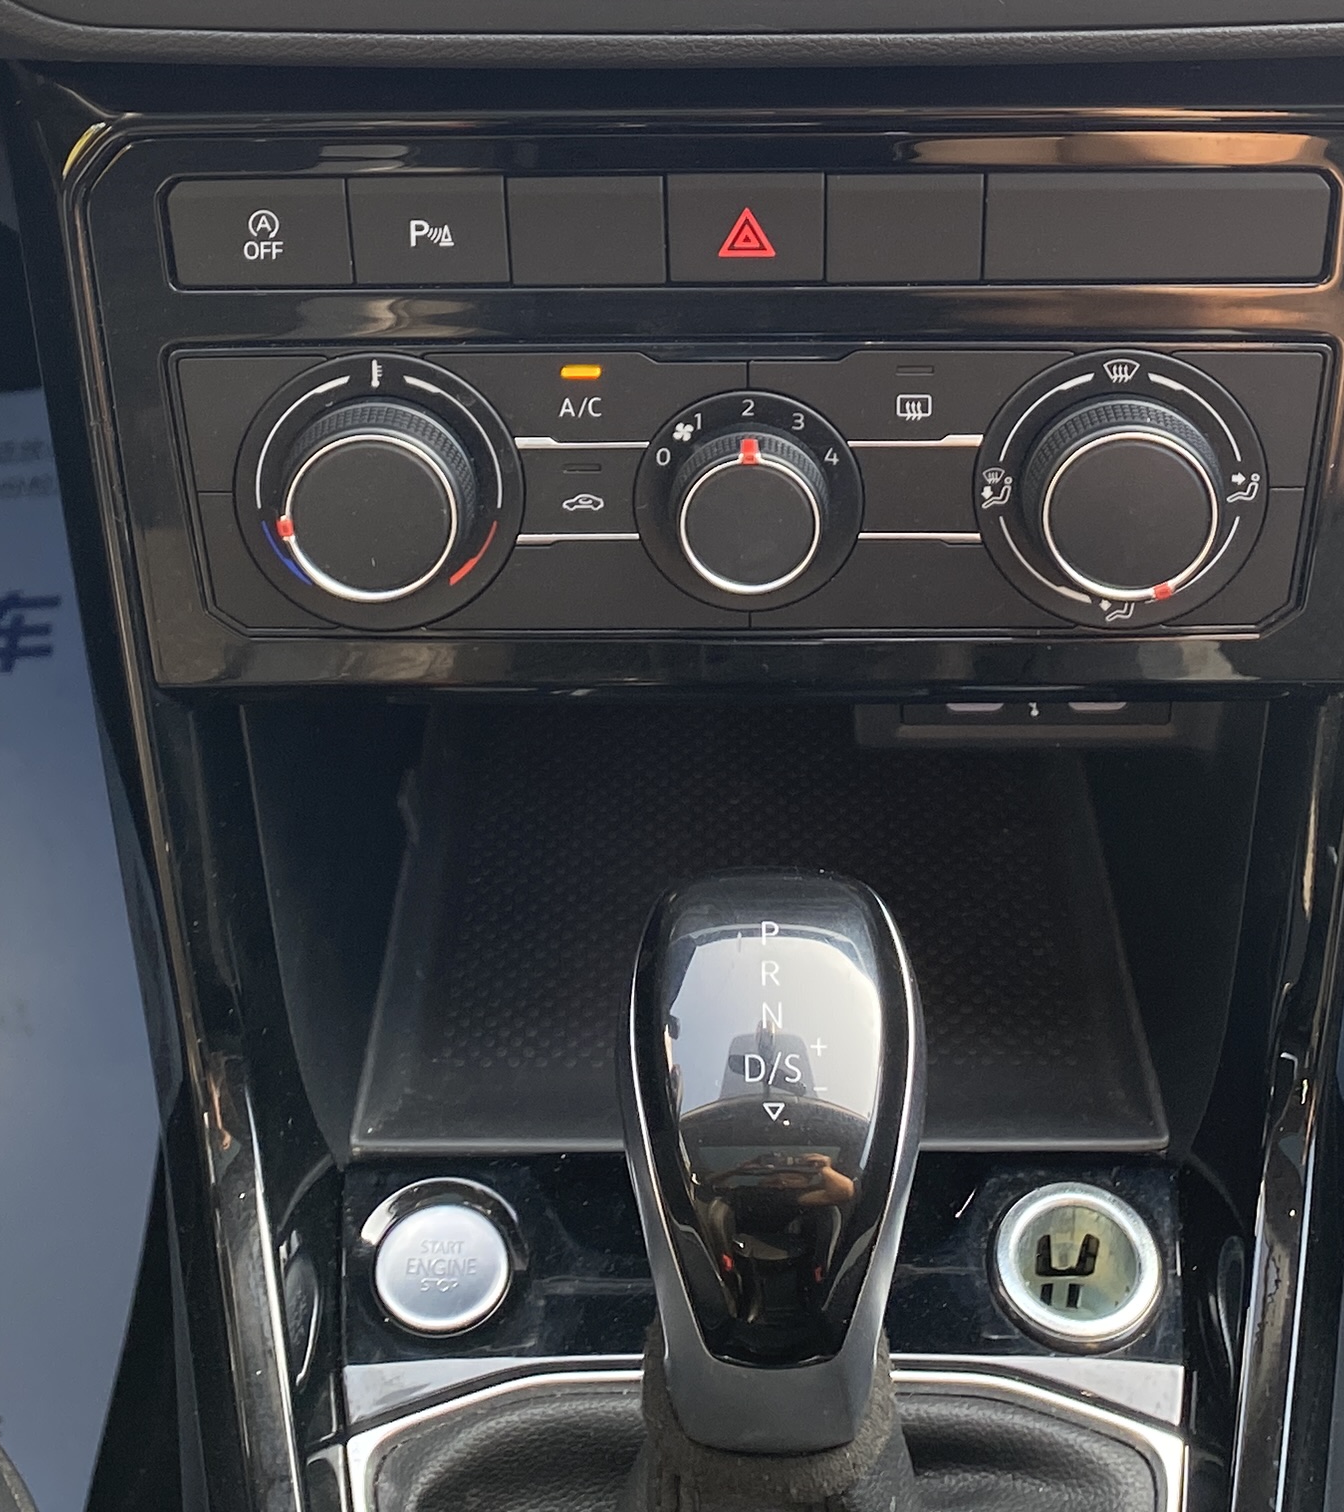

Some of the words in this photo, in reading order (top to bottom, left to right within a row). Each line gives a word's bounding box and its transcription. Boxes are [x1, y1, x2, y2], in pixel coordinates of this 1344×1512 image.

[243, 240, 284, 261] OFF
[559, 397, 602, 420] A/C
[742, 399, 755, 417] 2
[693, 412, 704, 431] 1
[792, 412, 806, 431] 3
[656, 448, 671, 467] 0
[823, 447, 840, 467] 4
[760, 920, 780, 946] P
[760, 959, 781, 987] R
[761, 1000, 784, 1030] N
[743, 1050, 803, 1086] D/S
[420, 1239, 465, 1255] START
[405, 1257, 478, 1276] ENGINE
